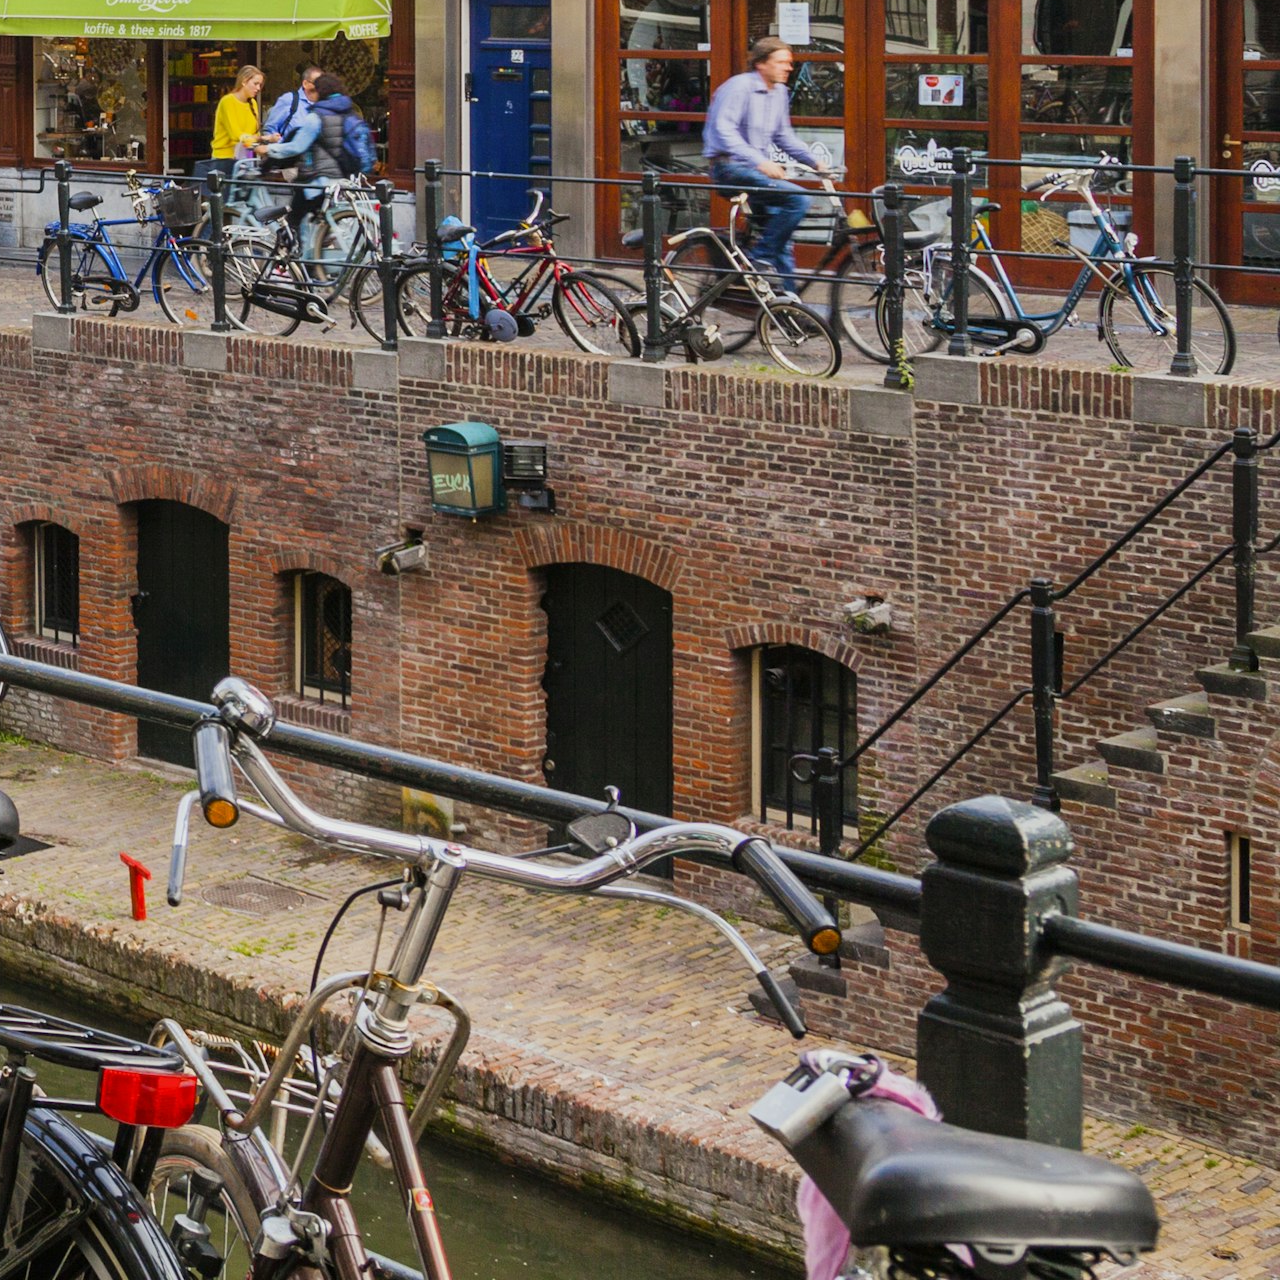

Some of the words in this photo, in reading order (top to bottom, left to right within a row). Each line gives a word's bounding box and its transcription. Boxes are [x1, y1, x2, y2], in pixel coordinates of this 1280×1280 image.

[84, 22, 115, 36] koffie
[117, 24, 127, 36] &
[130, 23, 155, 36] thee
[158, 24, 184, 37] sinds
[188, 25, 212, 37] 1817
[349, 23, 379, 37] KOFFIE
